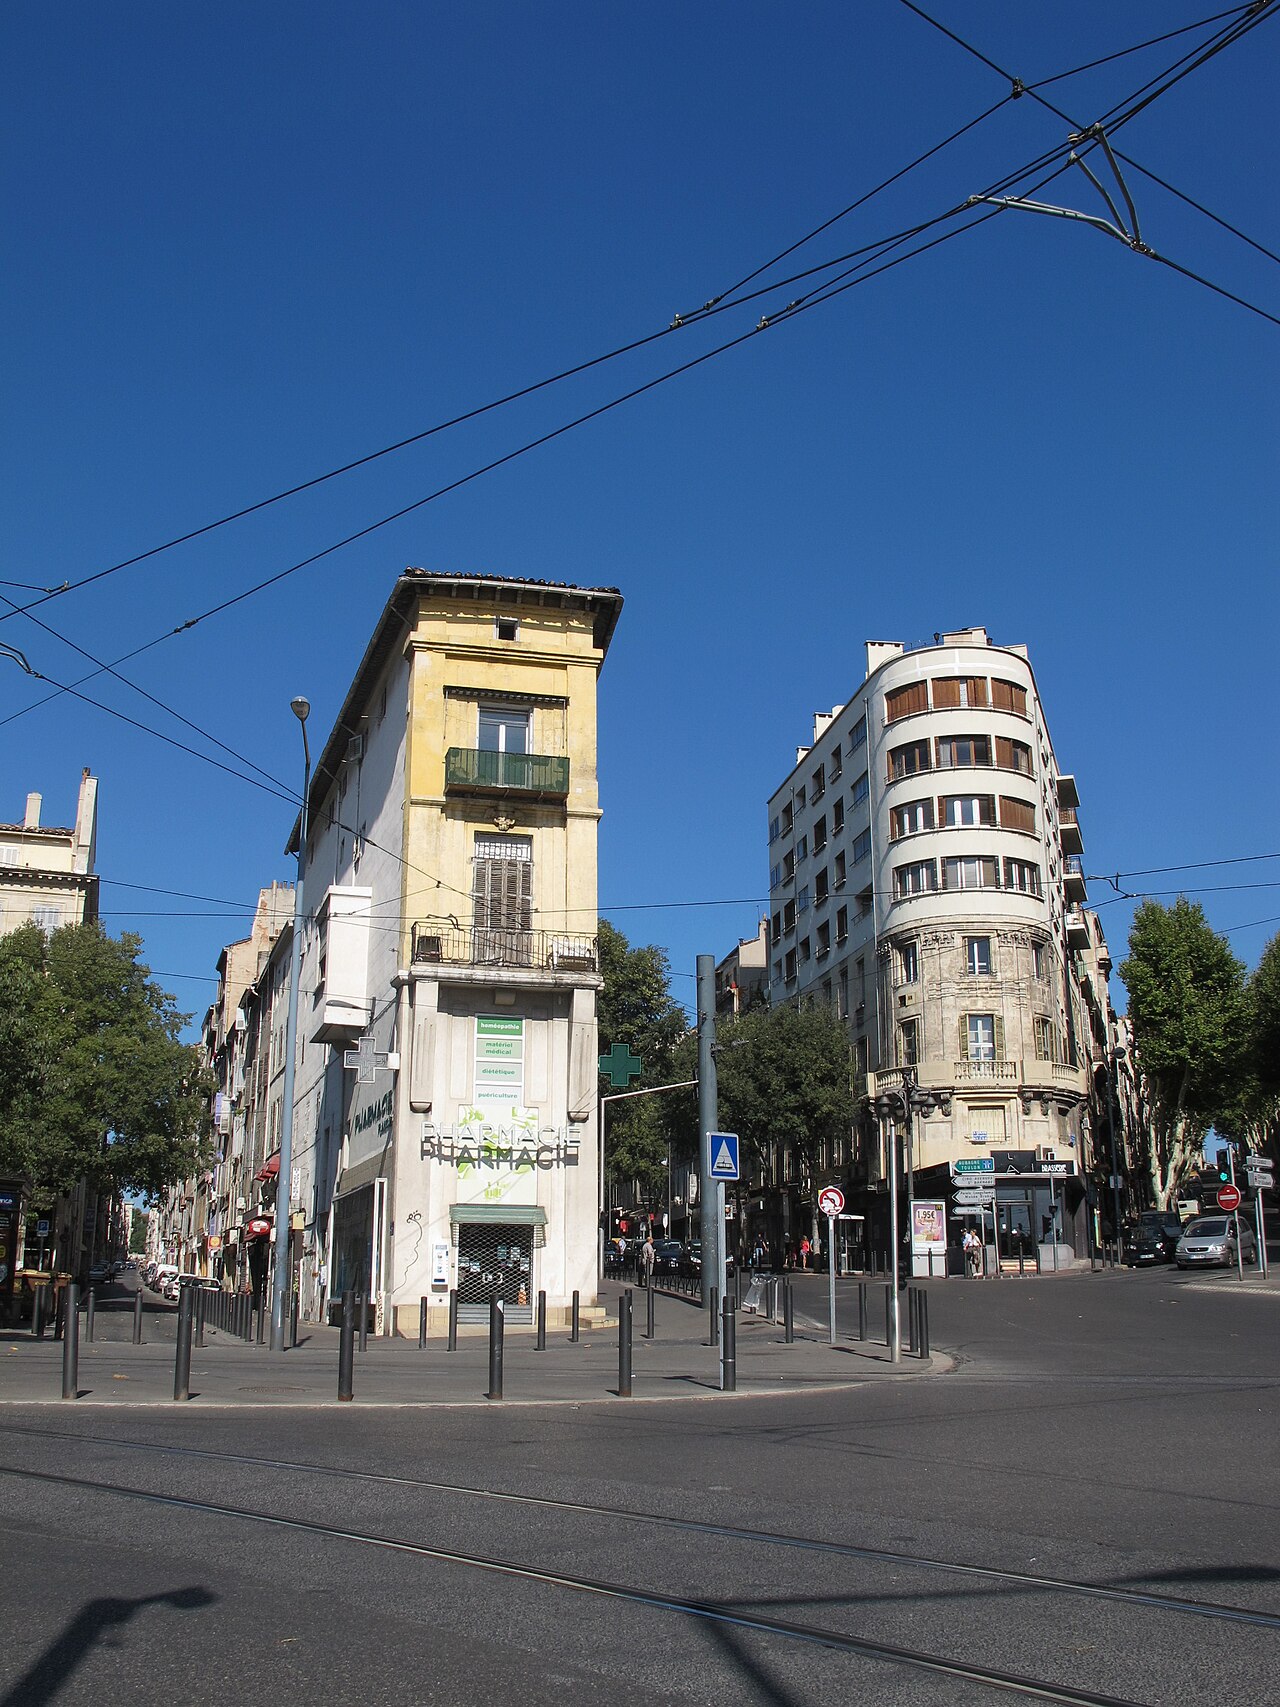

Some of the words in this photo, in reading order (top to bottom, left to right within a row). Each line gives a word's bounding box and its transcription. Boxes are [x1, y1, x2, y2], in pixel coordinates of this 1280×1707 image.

[480, 1022, 520, 1030] homéopathie
[485, 1041, 513, 1049] matériel
[482, 1067, 516, 1075] diététique
[477, 1092, 518, 1100] puériculture
[420, 1121, 582, 1147] PHARMACIE
[1041, 1164, 1067, 1172] BRASSERIE
